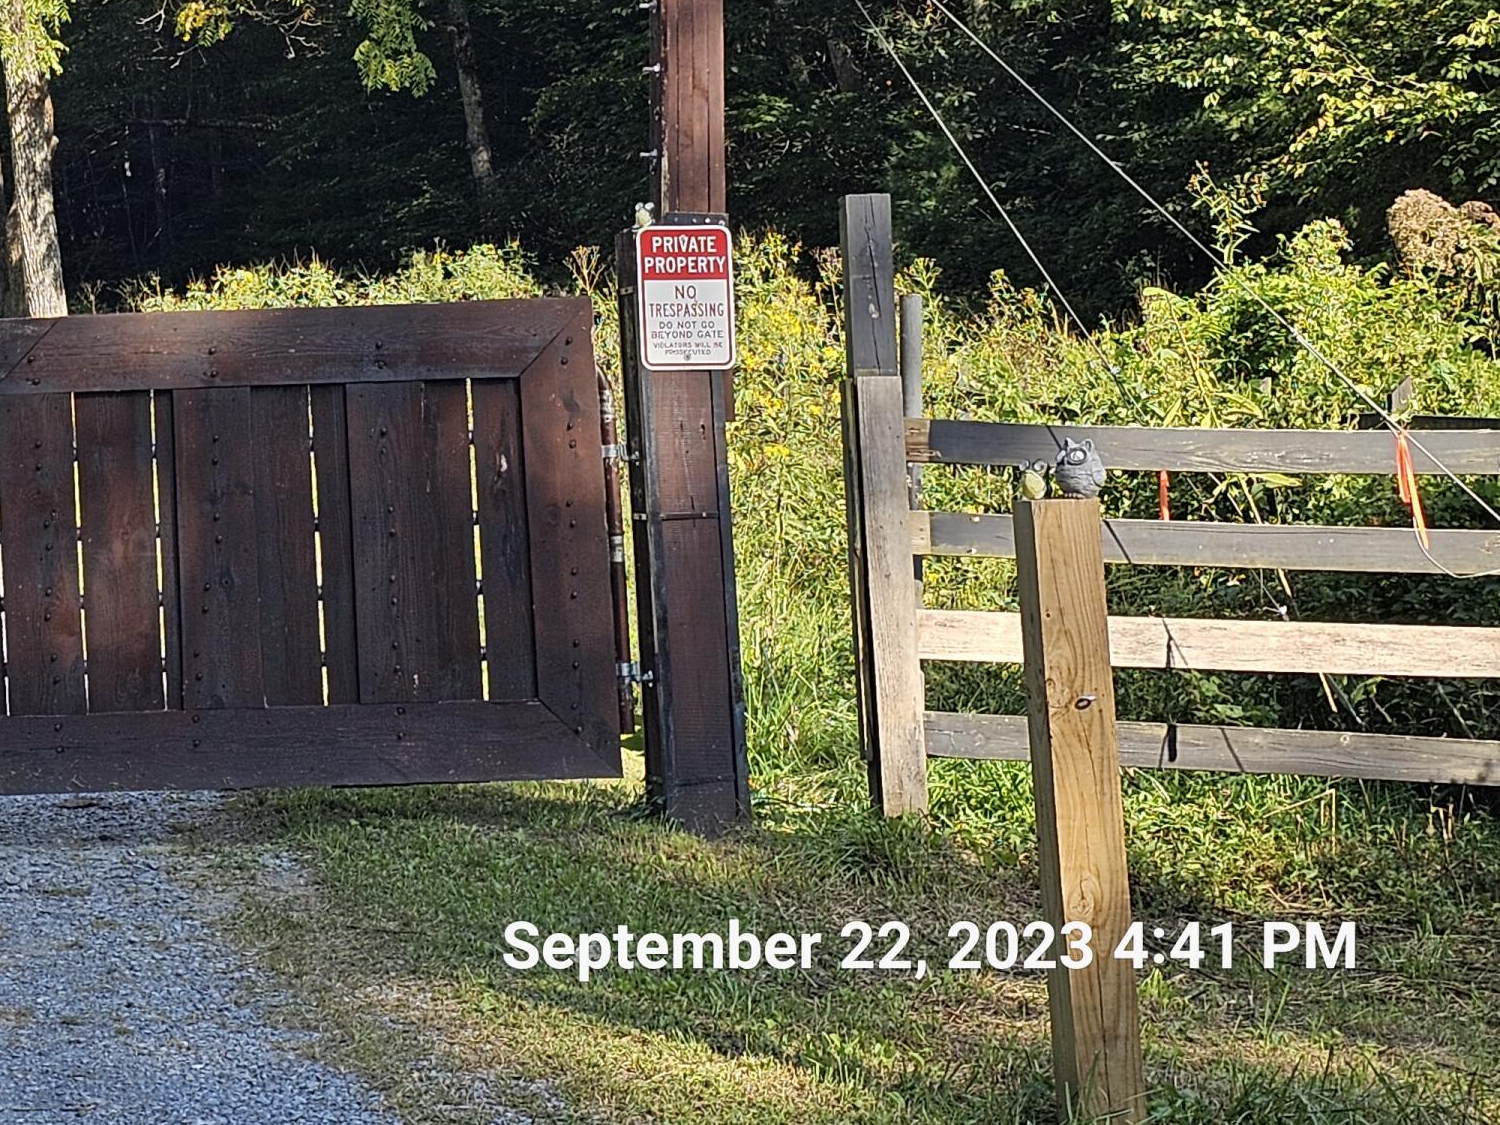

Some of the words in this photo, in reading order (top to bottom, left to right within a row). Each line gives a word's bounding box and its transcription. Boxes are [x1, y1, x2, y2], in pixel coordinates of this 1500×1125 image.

[652, 236, 717, 253] PRIVATE
[644, 256, 726, 274] PROPERTY
[675, 284, 696, 299] NO
[649, 303, 724, 318] TRESPASSING
[659, 321, 672, 329] DO
[678, 321, 697, 329] NOT
[701, 321, 715, 329] GO
[651, 331, 692, 339] BEYOND
[697, 330, 724, 338] GATE
